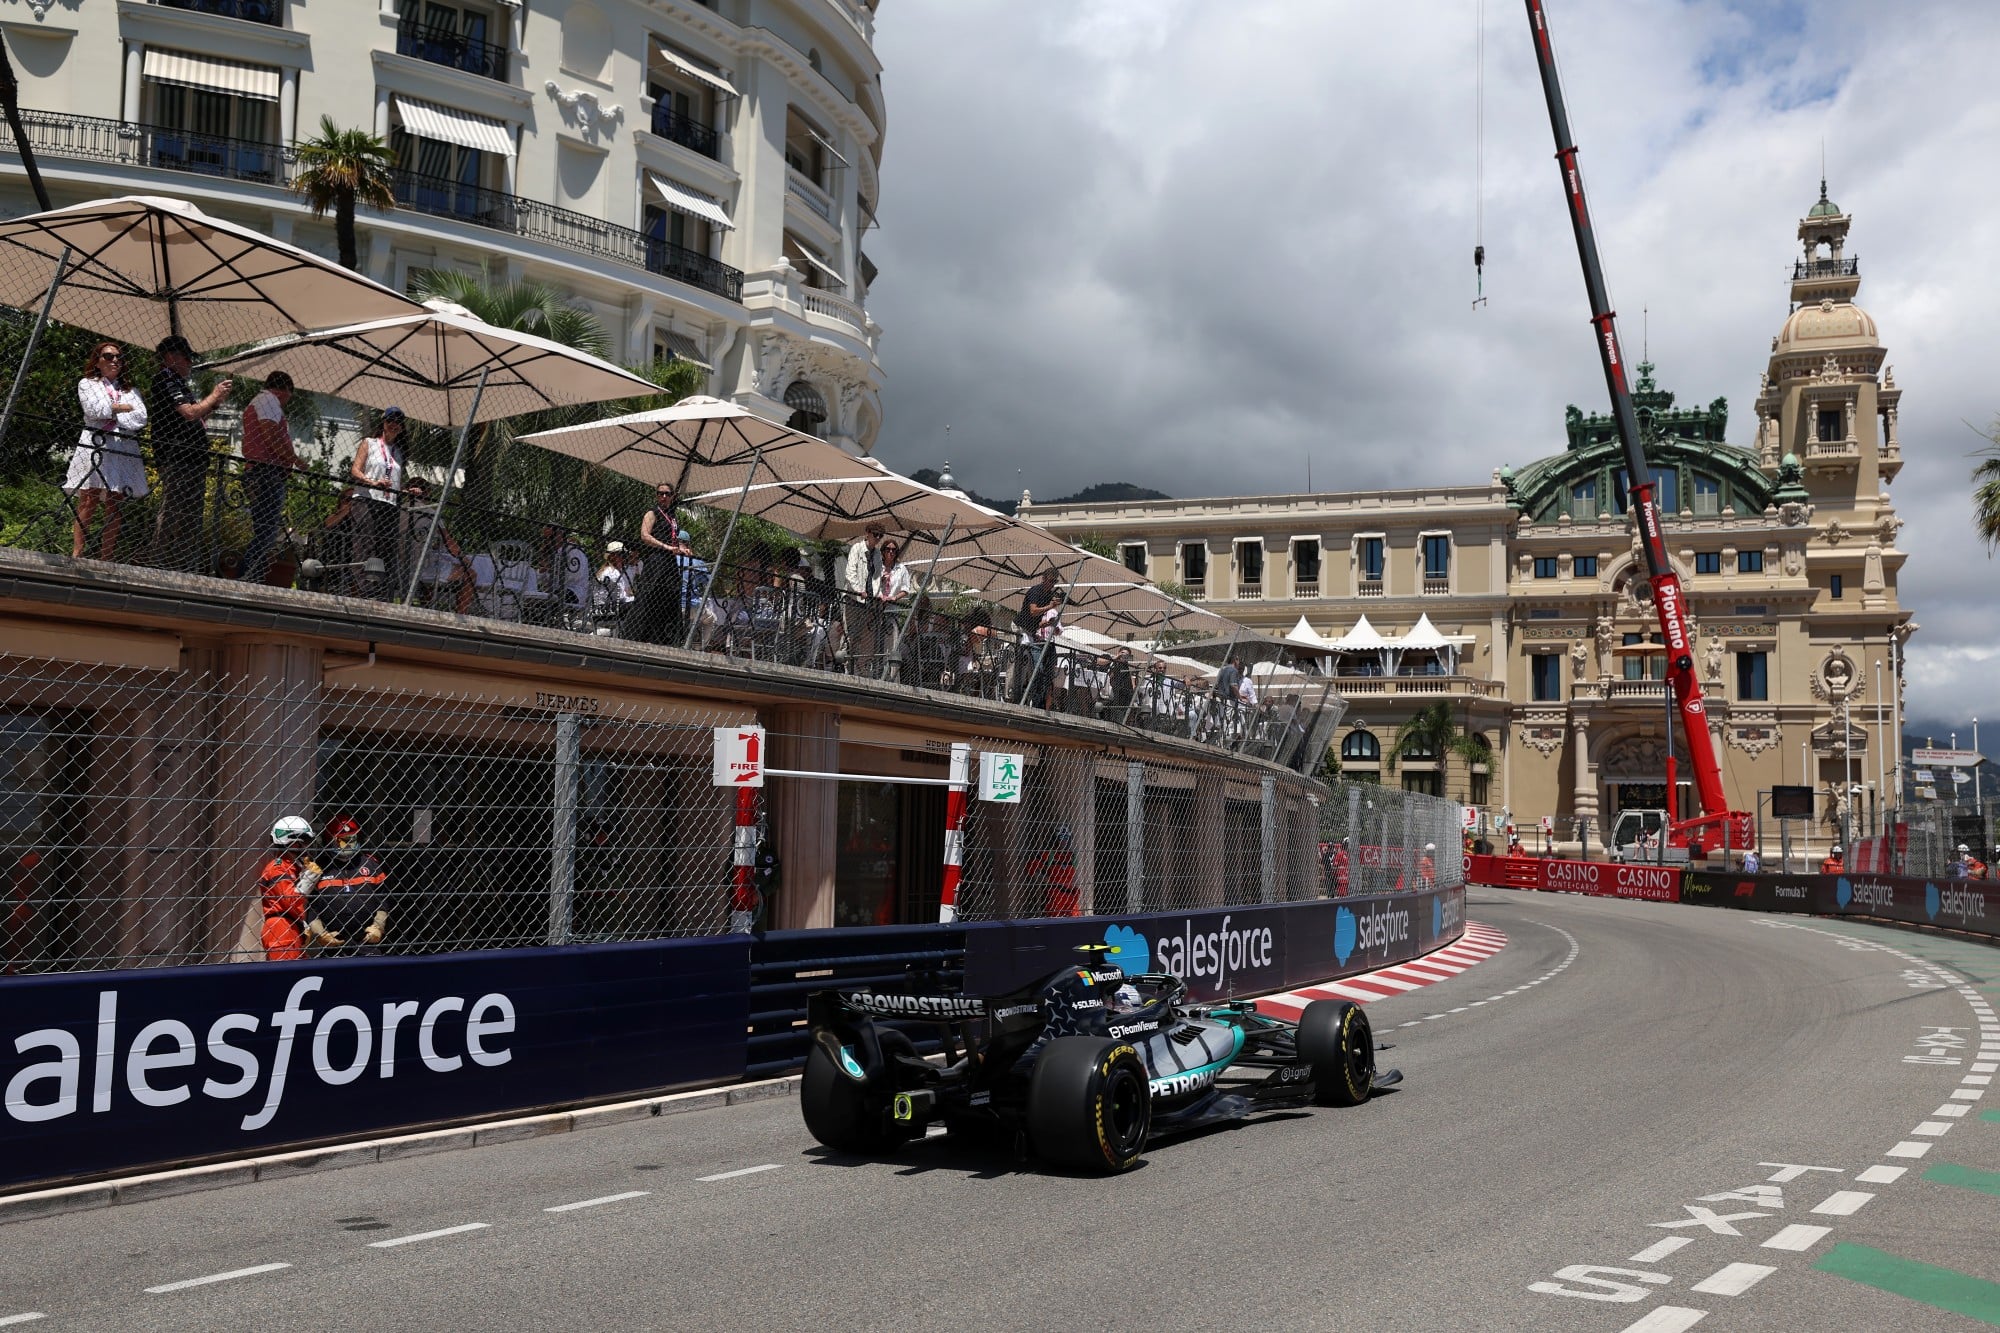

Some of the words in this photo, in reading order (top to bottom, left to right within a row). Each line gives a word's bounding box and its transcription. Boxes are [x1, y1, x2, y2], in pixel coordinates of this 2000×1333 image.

[1642, 501, 1656, 538] Piovano
[1659, 584, 1684, 649] Piovano
[1547, 862, 1599, 883] CASINO
[1617, 868, 1671, 889] CASINO
[1775, 886, 1800, 897] Formula
[1853, 877, 1893, 912] salesforce
[1941, 883, 1985, 925] salesforce
[1359, 900, 1409, 958] salesforce
[1157, 915, 1272, 991] salesforce
[1091, 968, 1123, 983] Microsoft
[851, 993, 986, 1016] CROWDSTRIKE
[1120, 1020, 1159, 1036] TeamViewer
[4, 976, 516, 1131] alesforce
[1108, 1045, 1135, 1064] ZERO
